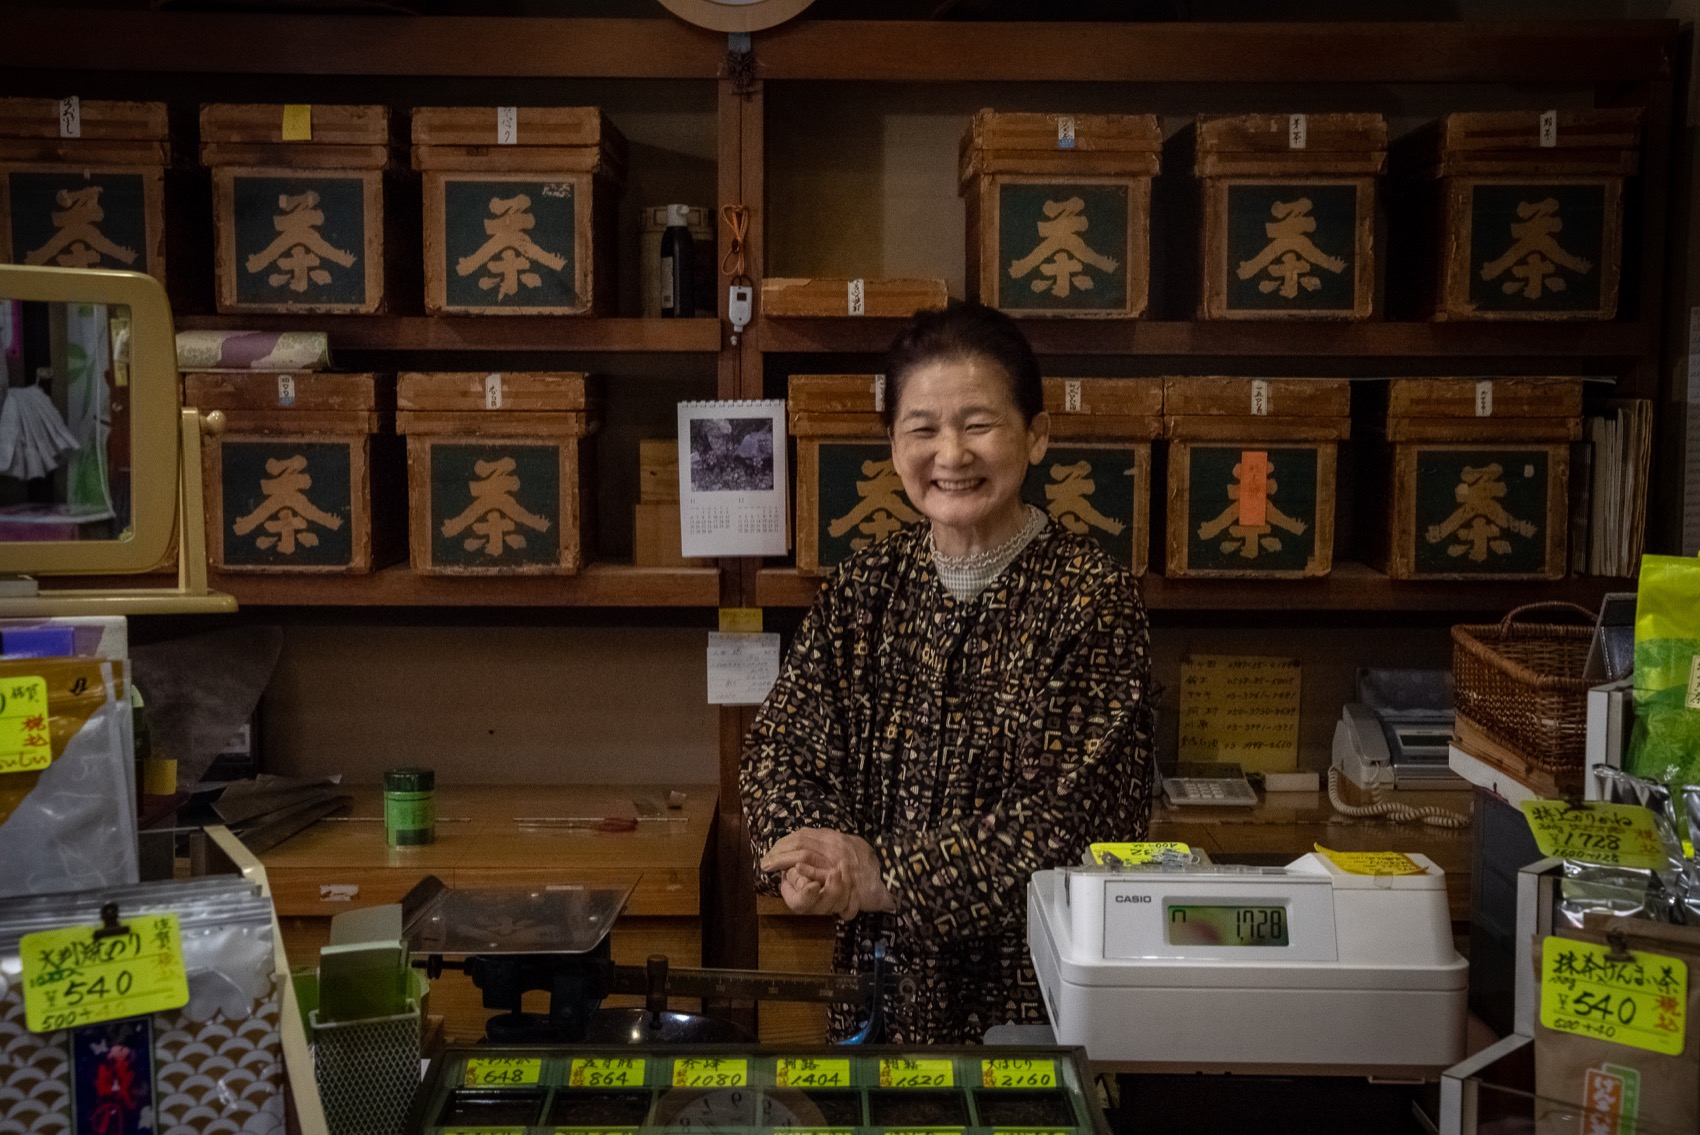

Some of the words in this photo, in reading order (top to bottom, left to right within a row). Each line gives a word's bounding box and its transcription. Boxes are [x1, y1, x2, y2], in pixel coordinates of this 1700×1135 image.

[246, 193, 357, 292] 茶
[456, 194, 567, 301] 茶
[1009, 197, 1118, 297] 茶
[1237, 198, 1348, 298] 茶
[1480, 198, 1593, 298] 茶
[233, 455, 343, 555] 茶
[441, 457, 551, 557] 茶
[1425, 463, 1539, 561] 茶
[1115, 895, 1152, 903] CASIO
[1236, 909, 1282, 941] 1,728
[484, 1069, 524, 1083] 648
[589, 1071, 629, 1085] 864
